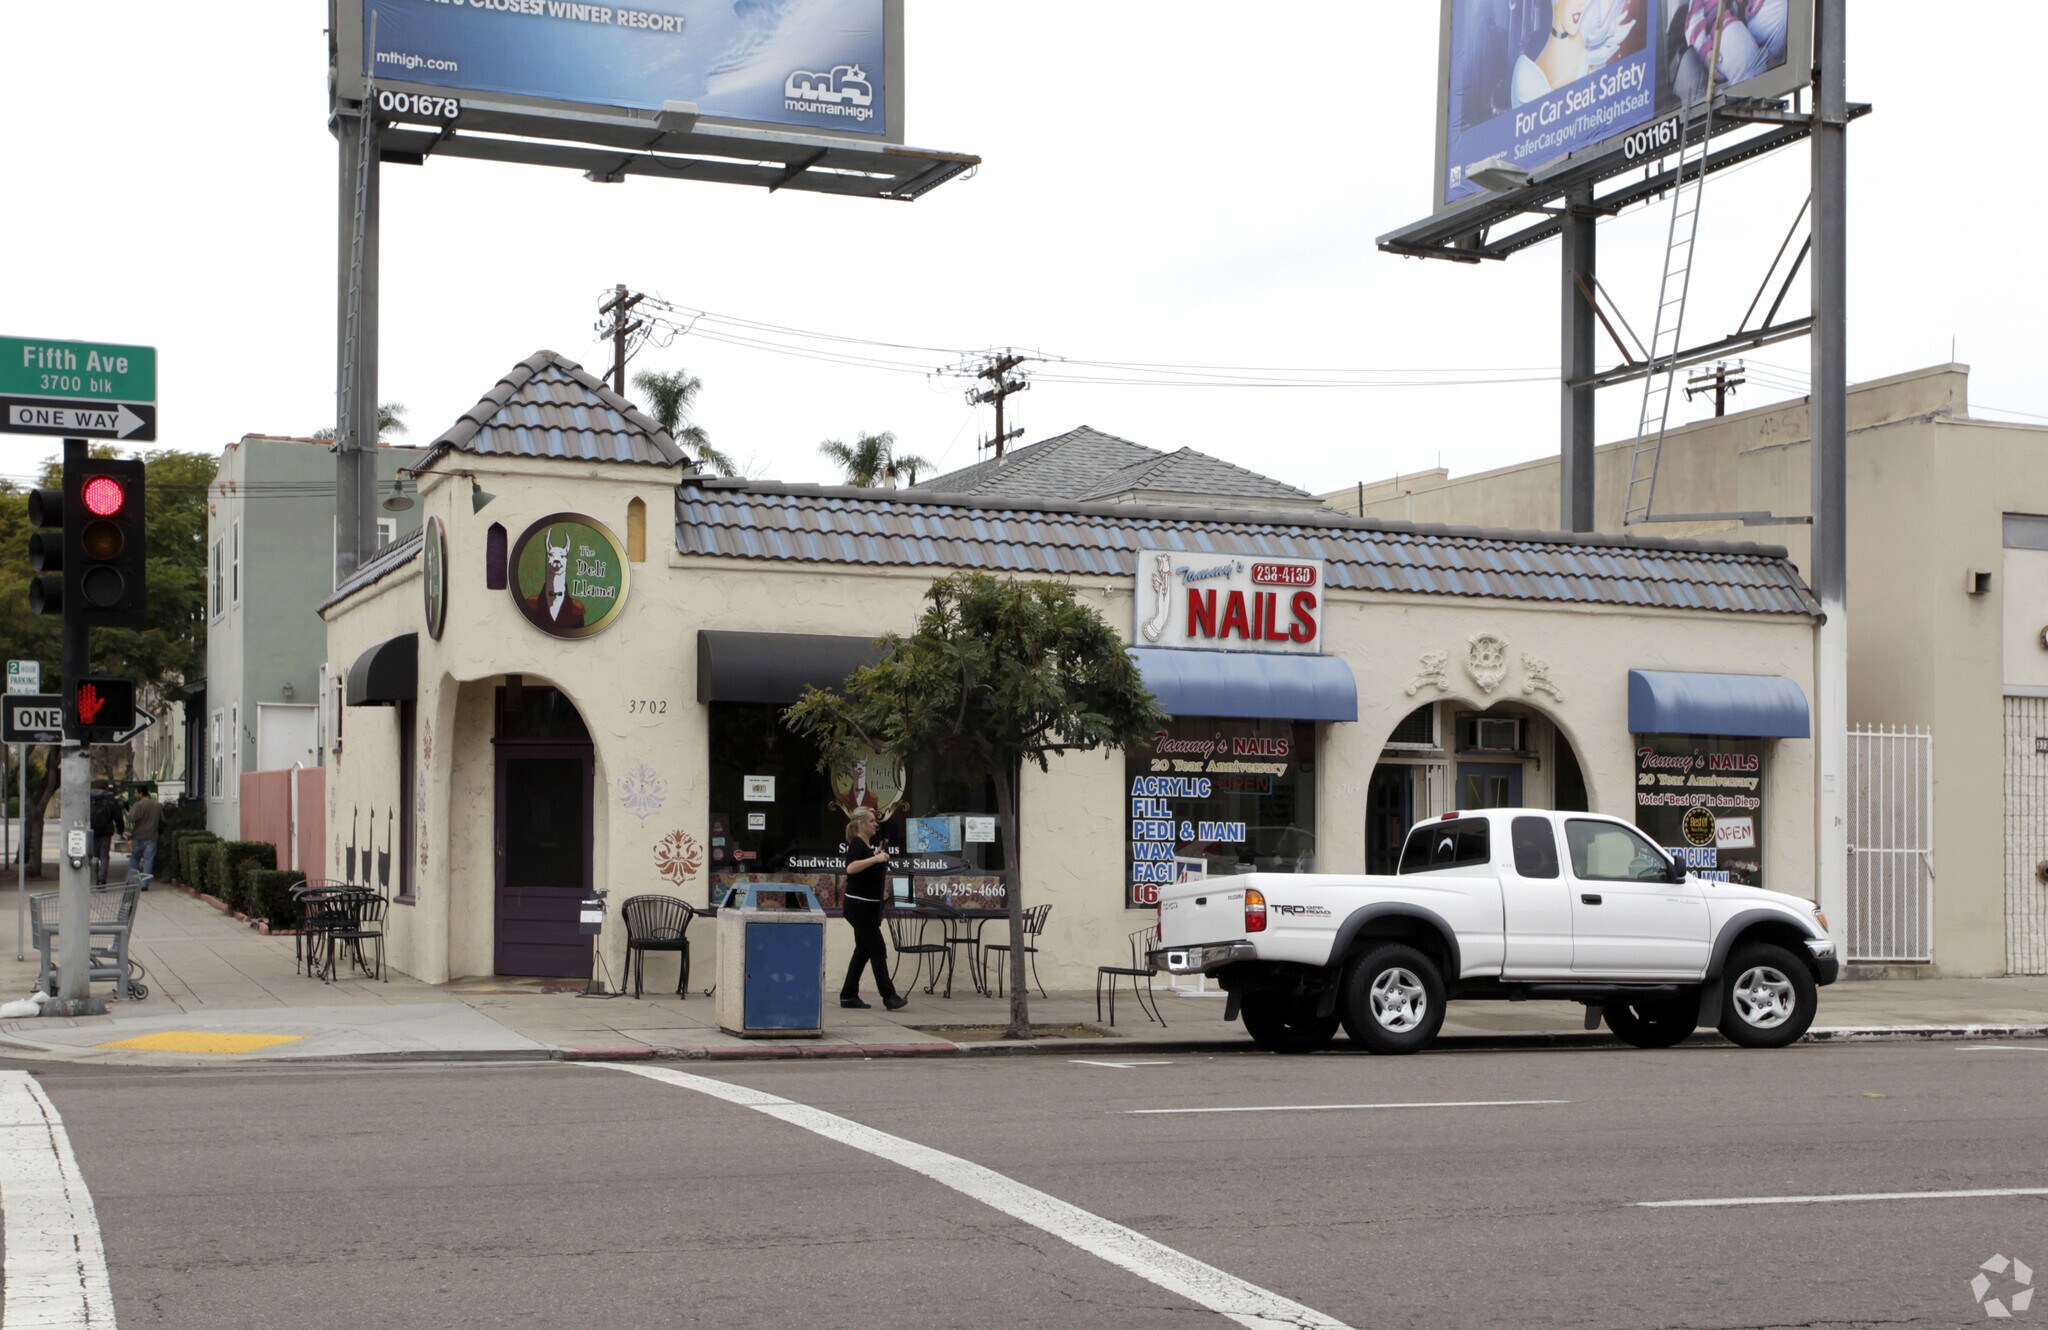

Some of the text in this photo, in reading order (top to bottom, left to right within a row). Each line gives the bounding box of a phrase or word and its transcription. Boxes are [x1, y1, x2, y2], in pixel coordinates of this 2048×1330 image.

[548, 2, 612, 24] WINTER
[617, 9, 684, 33] RESORT
[376, 52, 458, 72] mthigh.com
[379, 91, 459, 118] 001678
[1515, 62, 1646, 137] For Car Seat Safety
[1514, 89, 1650, 160] SaferCar.gov/TheRightSeat
[1624, 116, 1678, 160] 001161
[23, 345, 129, 374] Fifth Ave
[40, 374, 112, 394] 3700 blk
[19, 408, 119, 429] ONE WAY
[579, 545, 596, 557] The
[576, 559, 607, 577] Deli
[572, 579, 616, 598] Llama
[1186, 588, 1317, 643] NAILS
[10, 662, 18, 673] 2
[10, 676, 37, 685] PARKING
[629, 699, 667, 714] 3702
[19, 710, 61, 727] ONE
[1154, 732, 1289, 759] Tammy's NAILS
[1151, 759, 1288, 777] 20 Year Anniversary
[1637, 748, 1759, 774] Tammy's NAILS
[1131, 776, 1212, 798] ACRYLIC
[1638, 773, 1760, 790] 20 Year Anniversary
[1132, 799, 1172, 819] FILL
[1638, 793, 1663, 806] Voted
[1706, 795, 1716, 807] In
[1717, 795, 1733, 807] San
[1734, 795, 1760, 810] Diego
[1132, 820, 1246, 842] PEDI & MANI
[1717, 825, 1751, 841] OPEN
[1133, 842, 1175, 860] WAX
[789, 856, 847, 868] Sandwich
[913, 858, 948, 870] Salads
[1133, 862, 1174, 882] FACI
[926, 883, 1006, 897] 619-295-4666
[1270, 904, 1305, 916] TRD
